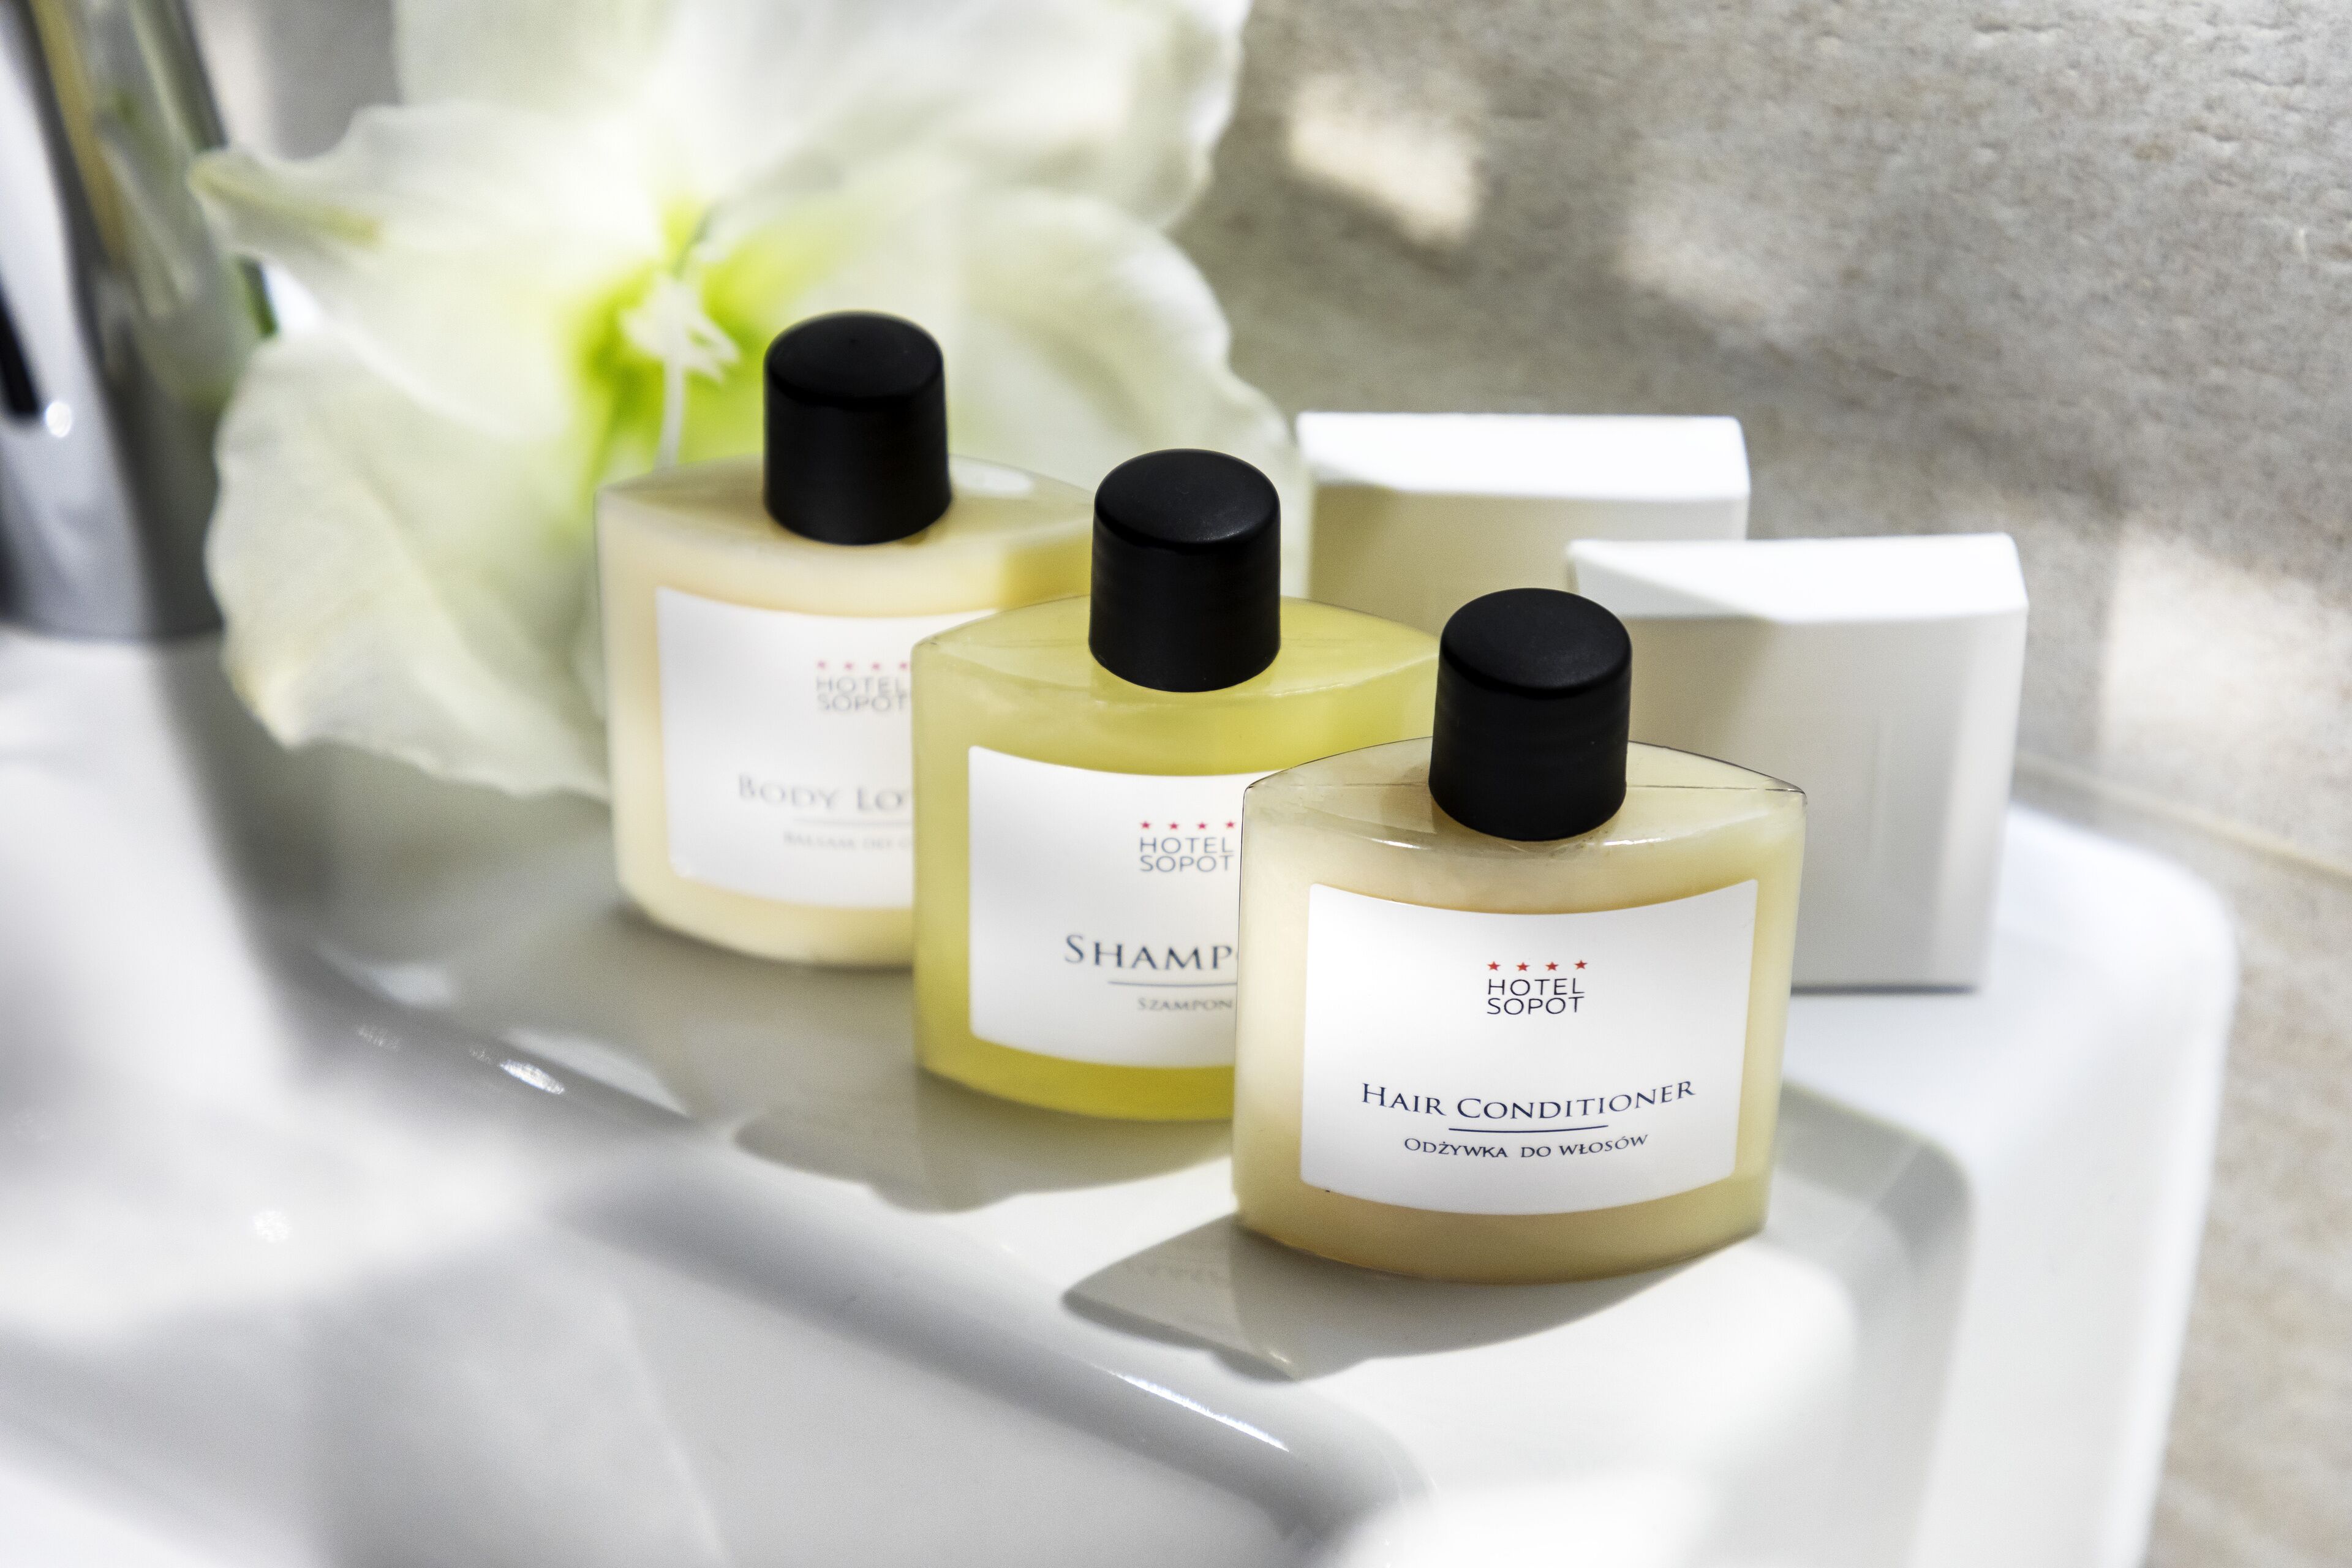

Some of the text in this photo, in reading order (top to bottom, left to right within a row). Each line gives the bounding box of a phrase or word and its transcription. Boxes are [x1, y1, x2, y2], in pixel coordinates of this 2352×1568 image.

[816, 675, 910, 693] HOTEL
[817, 693, 910, 712] SOPOT
[738, 773, 911, 812] BODY LO
[1139, 837, 1235, 854] HOTEL
[1139, 855, 1234, 872] SOPOT
[1064, 934, 1238, 970] SHAMP
[1487, 978, 1585, 996] HOTEL
[1137, 997, 1233, 1011] SZAMPON
[1487, 997, 1585, 1015] SOPOT
[1362, 1080, 1696, 1120] HAIR CONDITIONER
[1404, 1137, 1509, 1158] ODŻYWKA
[1521, 1146, 1551, 1158] DO
